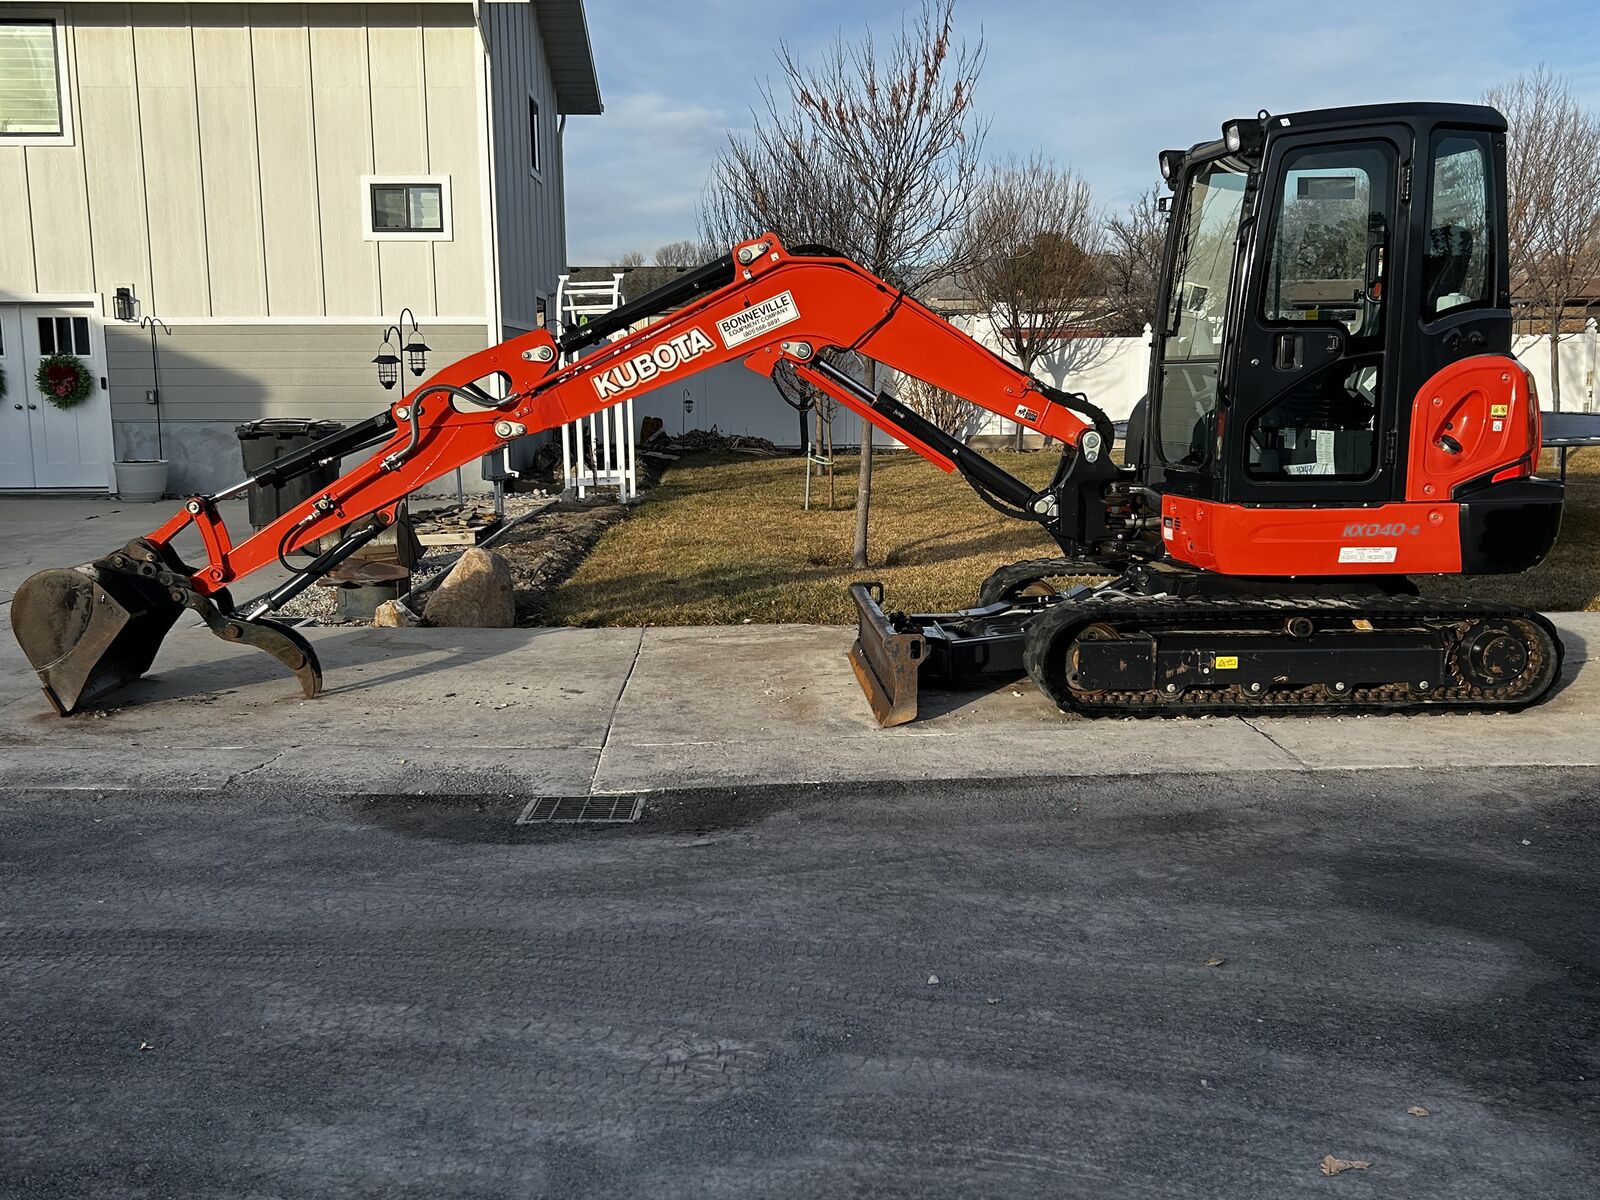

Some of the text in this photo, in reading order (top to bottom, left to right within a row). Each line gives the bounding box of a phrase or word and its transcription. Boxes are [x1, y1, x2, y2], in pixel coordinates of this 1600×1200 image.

[721, 295, 790, 332] BONNEVILLE
[728, 307, 789, 337] EQUIPMENT COMPANY
[591, 326, 715, 400] KUBOTA
[1342, 522, 1421, 538] KX040-4
